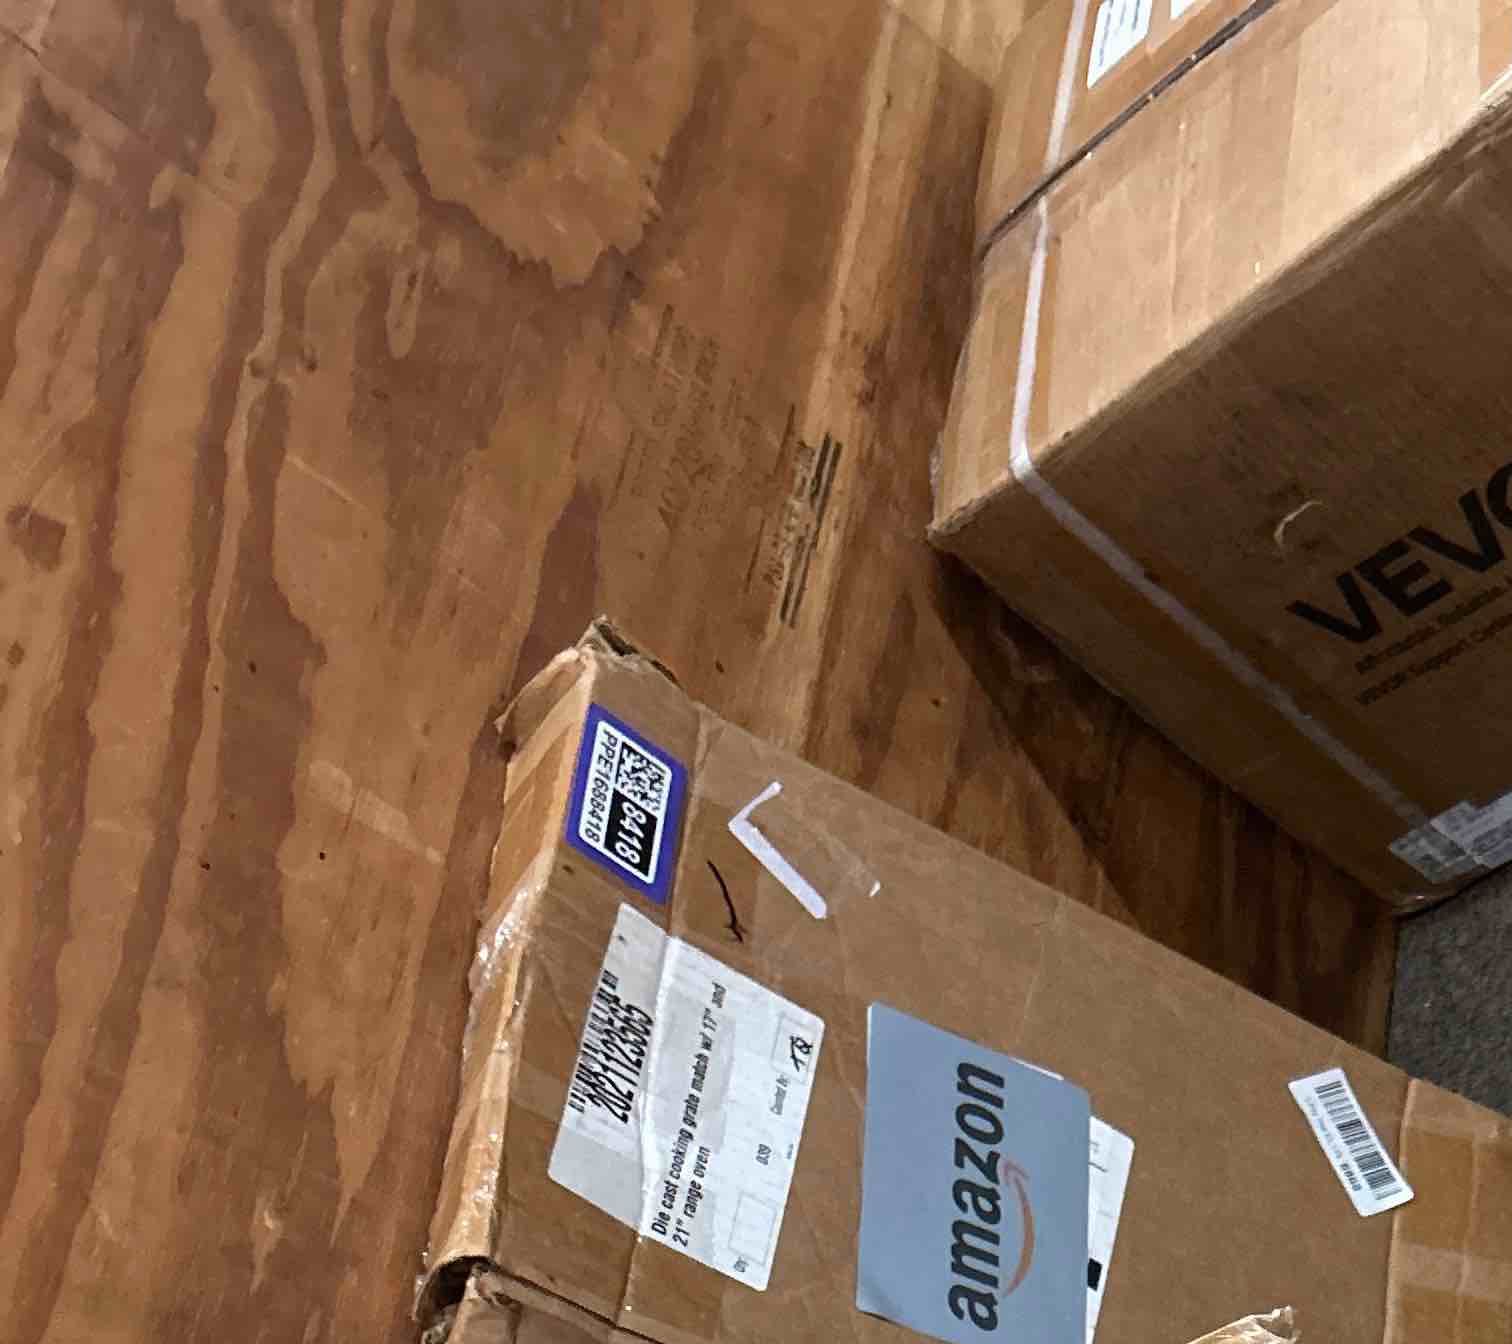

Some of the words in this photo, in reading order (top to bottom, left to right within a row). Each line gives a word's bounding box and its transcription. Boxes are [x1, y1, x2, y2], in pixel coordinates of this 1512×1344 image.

[585, 730, 617, 844] PPE1688418
[616, 799, 647, 865] 8418
[687, 1050, 709, 1093] match
[679, 1090, 702, 1129] grate
[666, 1125, 694, 1182] cooking
[691, 1143, 710, 1180] oven
[659, 1178, 678, 1210] cast
[681, 1177, 704, 1221] range
[948, 1062, 1006, 1331] amazon
[652, 1208, 671, 1237] Die
